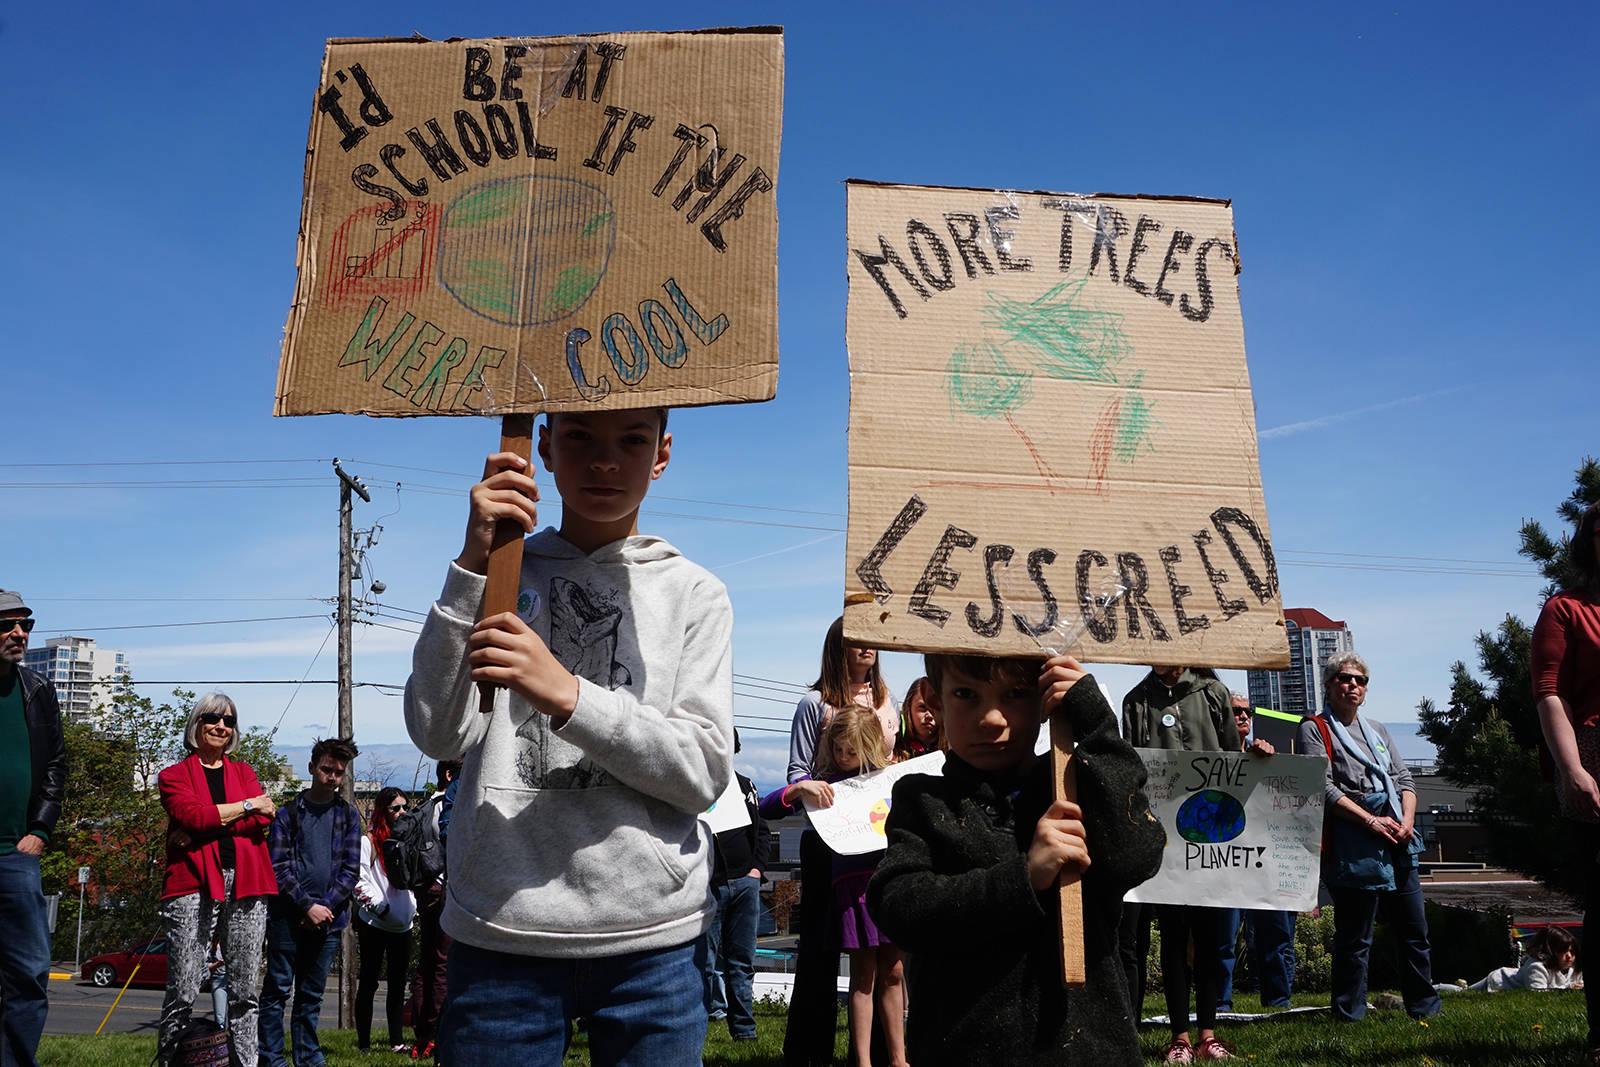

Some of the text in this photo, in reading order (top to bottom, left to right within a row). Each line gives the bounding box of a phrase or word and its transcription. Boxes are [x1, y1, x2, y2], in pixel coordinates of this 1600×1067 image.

[320, 42, 626, 152] I'd BE AT
[352, 101, 773, 253] SCHOOL IF THE
[853, 196, 1233, 323] MORE TREES
[338, 277, 730, 412] WERE COOL
[856, 493, 1279, 643] LESS GREED
[1185, 757, 1250, 792] SAVE
[1264, 775, 1300, 794] TAKE
[1185, 842, 1267, 870] PLANET!
